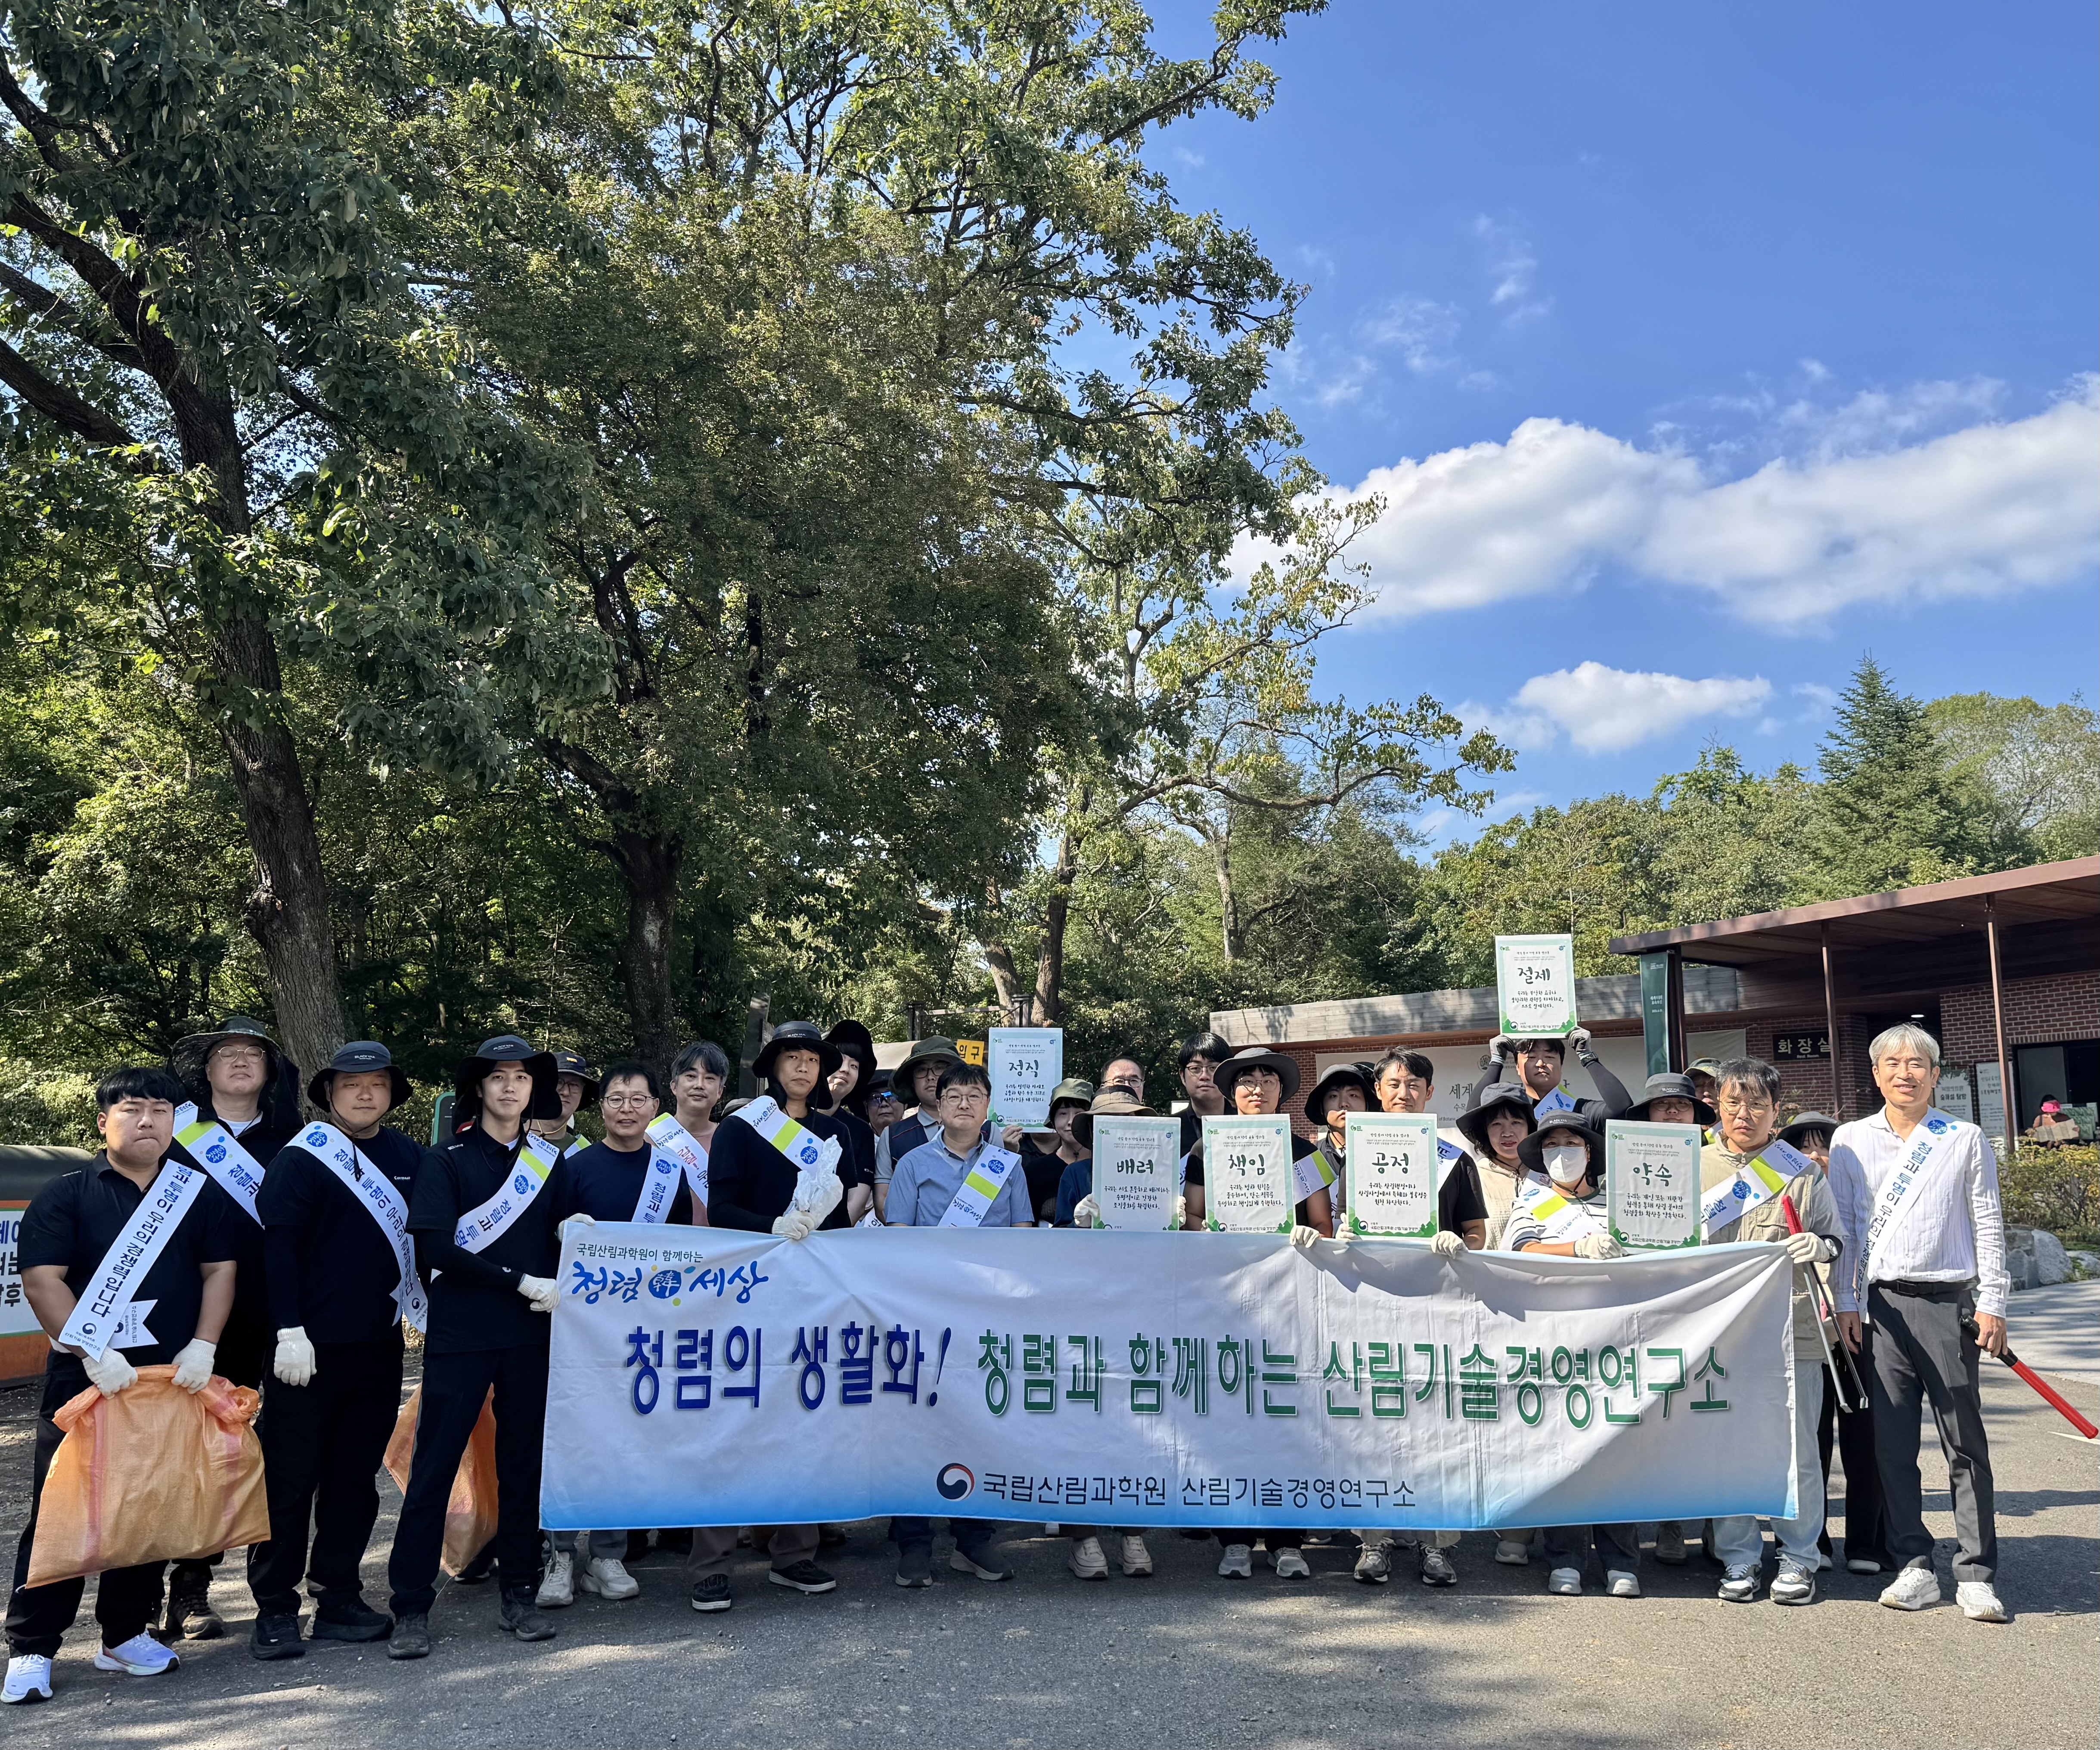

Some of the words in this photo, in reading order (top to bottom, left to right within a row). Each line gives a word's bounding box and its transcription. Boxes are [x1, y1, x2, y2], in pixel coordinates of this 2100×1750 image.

[1517, 966, 1550, 984] 절제
[1778, 1038, 1831, 1054] 화장실
[1008, 1059, 1039, 1078] 정직
[1117, 1158, 1154, 1174] 배려
[1228, 1154, 1265, 1176] 책임
[1371, 1152, 1409, 1174] 공정
[1903, 1141, 1933, 1174] 청렴과
[228, 1164, 260, 1197] 청렴과
[1633, 1162, 1672, 1186] 약속
[1886, 1172, 1912, 1205] 투명이
[157, 1181, 184, 1213] 투명이
[361, 1177, 391, 1209] 투명이
[647, 1182, 667, 1213] 청렴과
[133, 1211, 164, 1245] 우리의
[478, 1199, 512, 1232] 청렴과
[1870, 1205, 1892, 1238] 우리의
[577, 1243, 658, 1261] 국립산림과학원이
[662, 1250, 704, 1263] 함께하는
[91, 1242, 144, 1318] 경쟁력입니다
[572, 1261, 642, 1304] 청렴
[689, 1261, 769, 1304] 세상
[627, 1326, 762, 1415] 청렴의
[791, 1321, 952, 1410] 생활화!
[977, 1329, 1105, 1416] 청렴과
[1129, 1332, 1297, 1416] 함께하는
[1323, 1339, 1729, 1430] 산림기술경영연구소
[983, 1473, 1166, 1507] 국립산림과학원
[1182, 1476, 1417, 1509] 산림기술경영연구소
